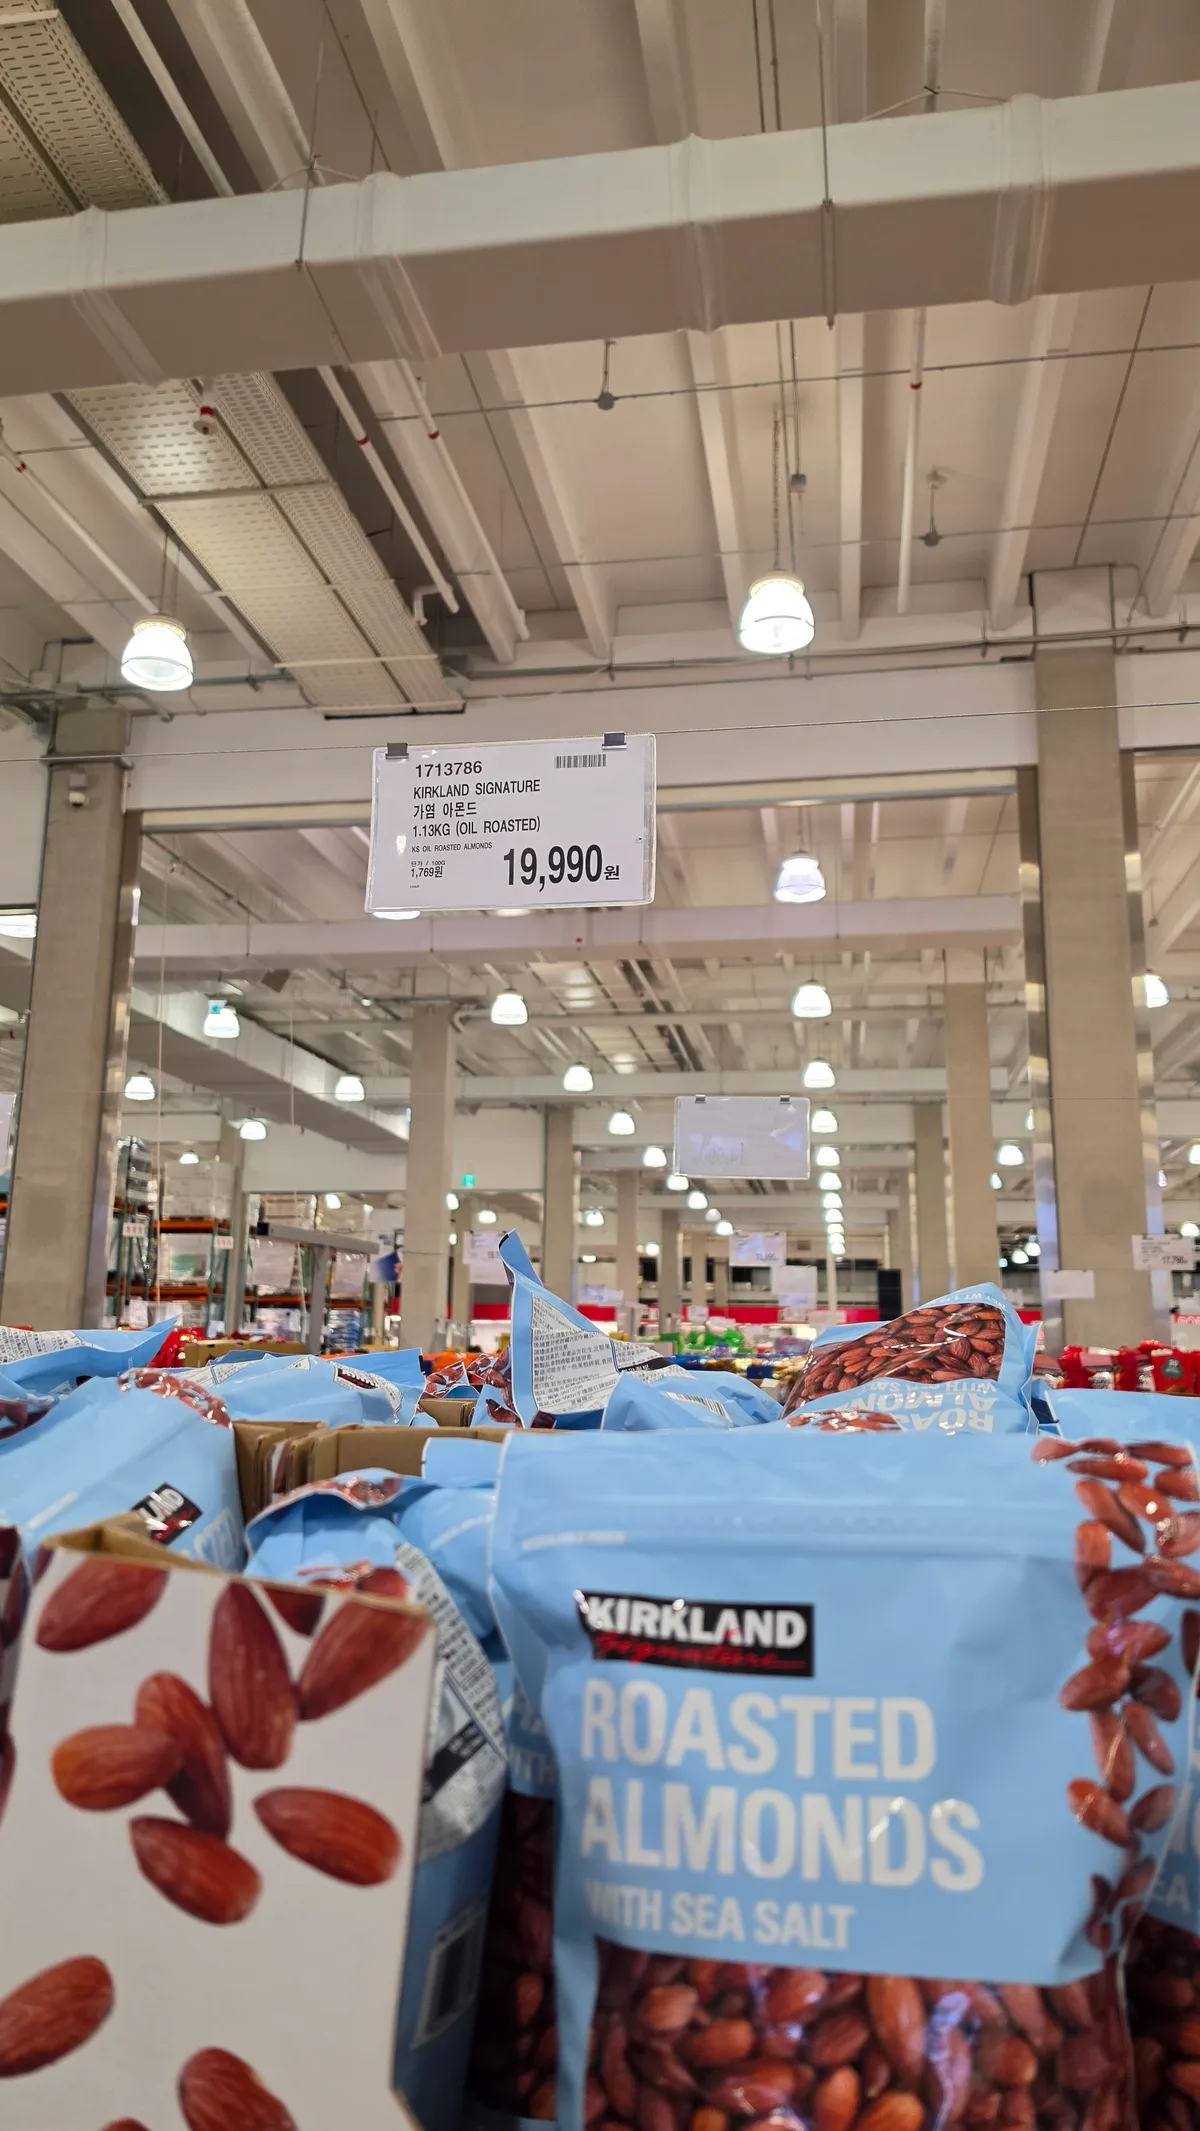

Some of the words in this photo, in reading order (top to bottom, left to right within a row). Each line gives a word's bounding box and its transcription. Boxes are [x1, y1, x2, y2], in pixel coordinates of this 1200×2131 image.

[415, 761, 482, 778] 1713786
[413, 783, 470, 799] KIRKLAND
[475, 779, 541, 796] SIGNATURE
[413, 803, 435, 819] 가염
[443, 802, 477, 818] 아몬드
[412, 823, 450, 838] 1.13KG
[456, 820, 478, 838] (OIL
[484, 815, 541, 834] ROASTED)
[422, 845, 433, 853] OIL
[434, 843, 461, 852] ROASTED
[463, 842, 493, 851] ALMONDS
[410, 866, 443, 878] 1,769원
[585, 1596, 807, 1649] KIRKLAND
[594, 1633, 806, 1672] Signature
[581, 1678, 937, 1783] ROASTED
[581, 1776, 985, 1892] ALMONDS
[585, 1878, 661, 1933] WITH
[671, 1892, 744, 1941] SEA
[754, 1899, 855, 1950] SALT
